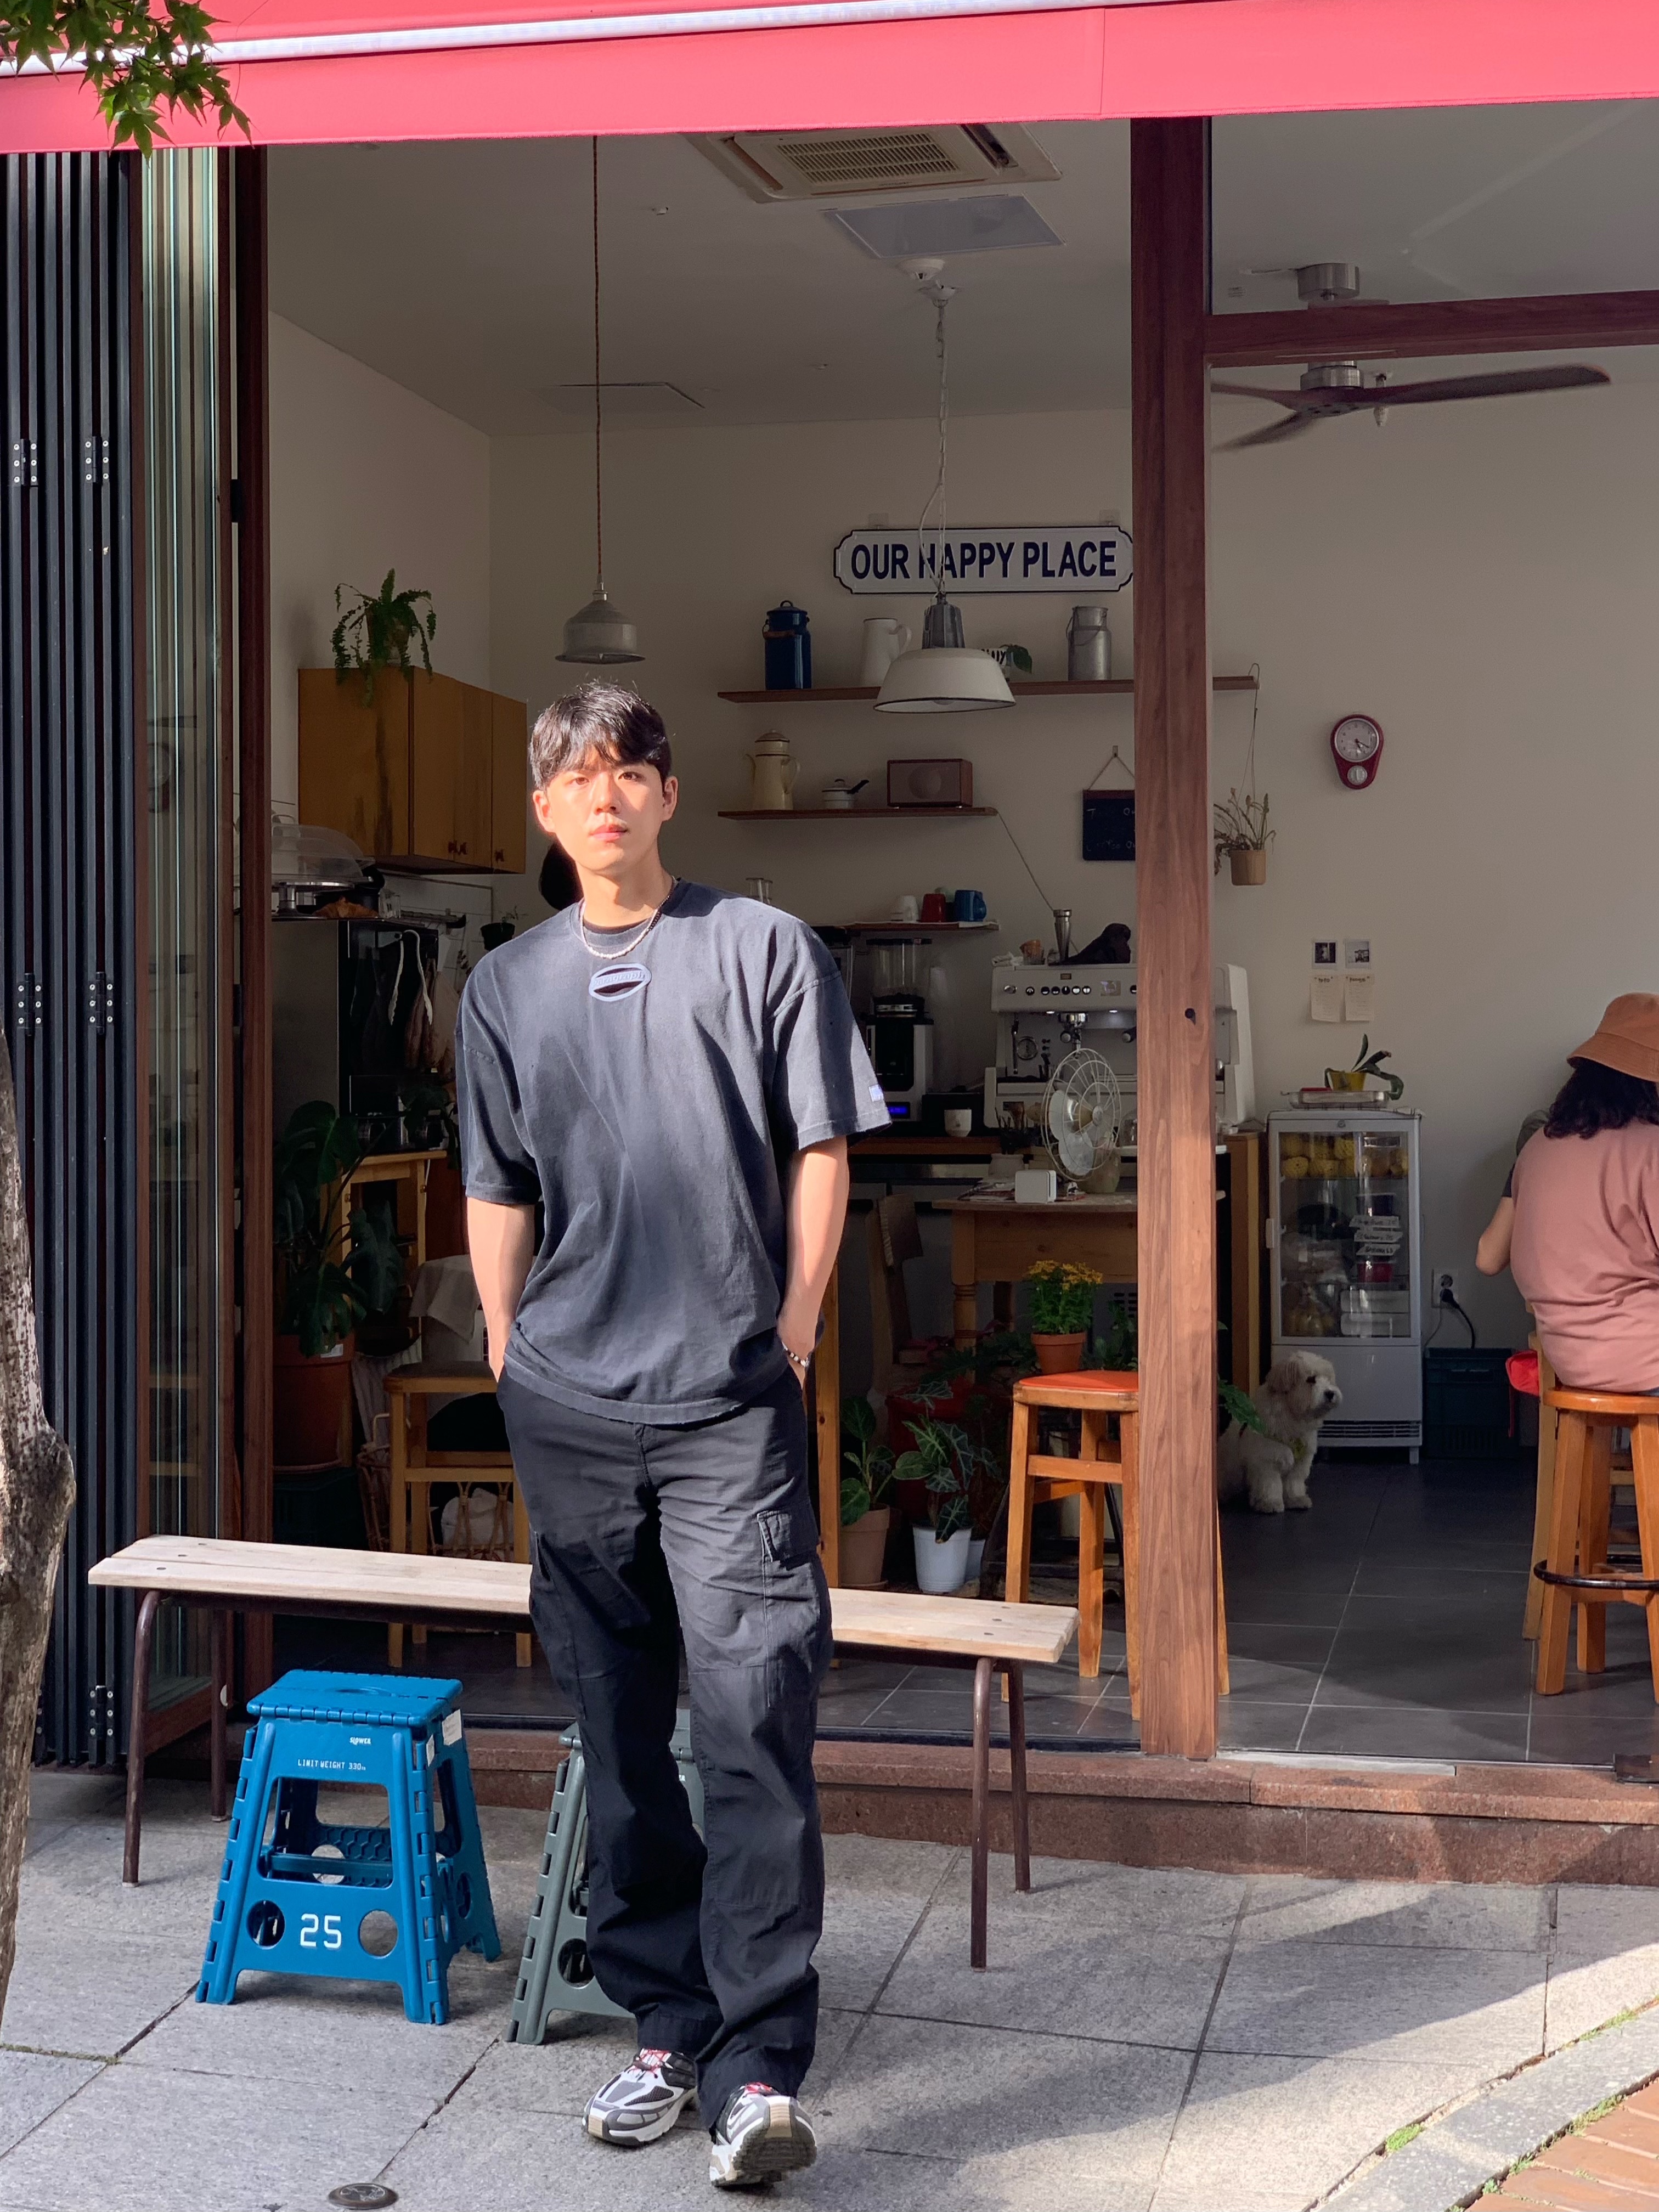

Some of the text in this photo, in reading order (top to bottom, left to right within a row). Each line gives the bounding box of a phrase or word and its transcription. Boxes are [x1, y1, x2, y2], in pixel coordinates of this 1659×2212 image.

[851, 540, 1116, 579] OUR HAPPY PLACE
[349, 1736, 371, 1745] SLOWER
[298, 1759, 318, 1767] LIMIT
[320, 1760, 346, 1769] WEIGHT
[300, 1913, 342, 1949] 25
